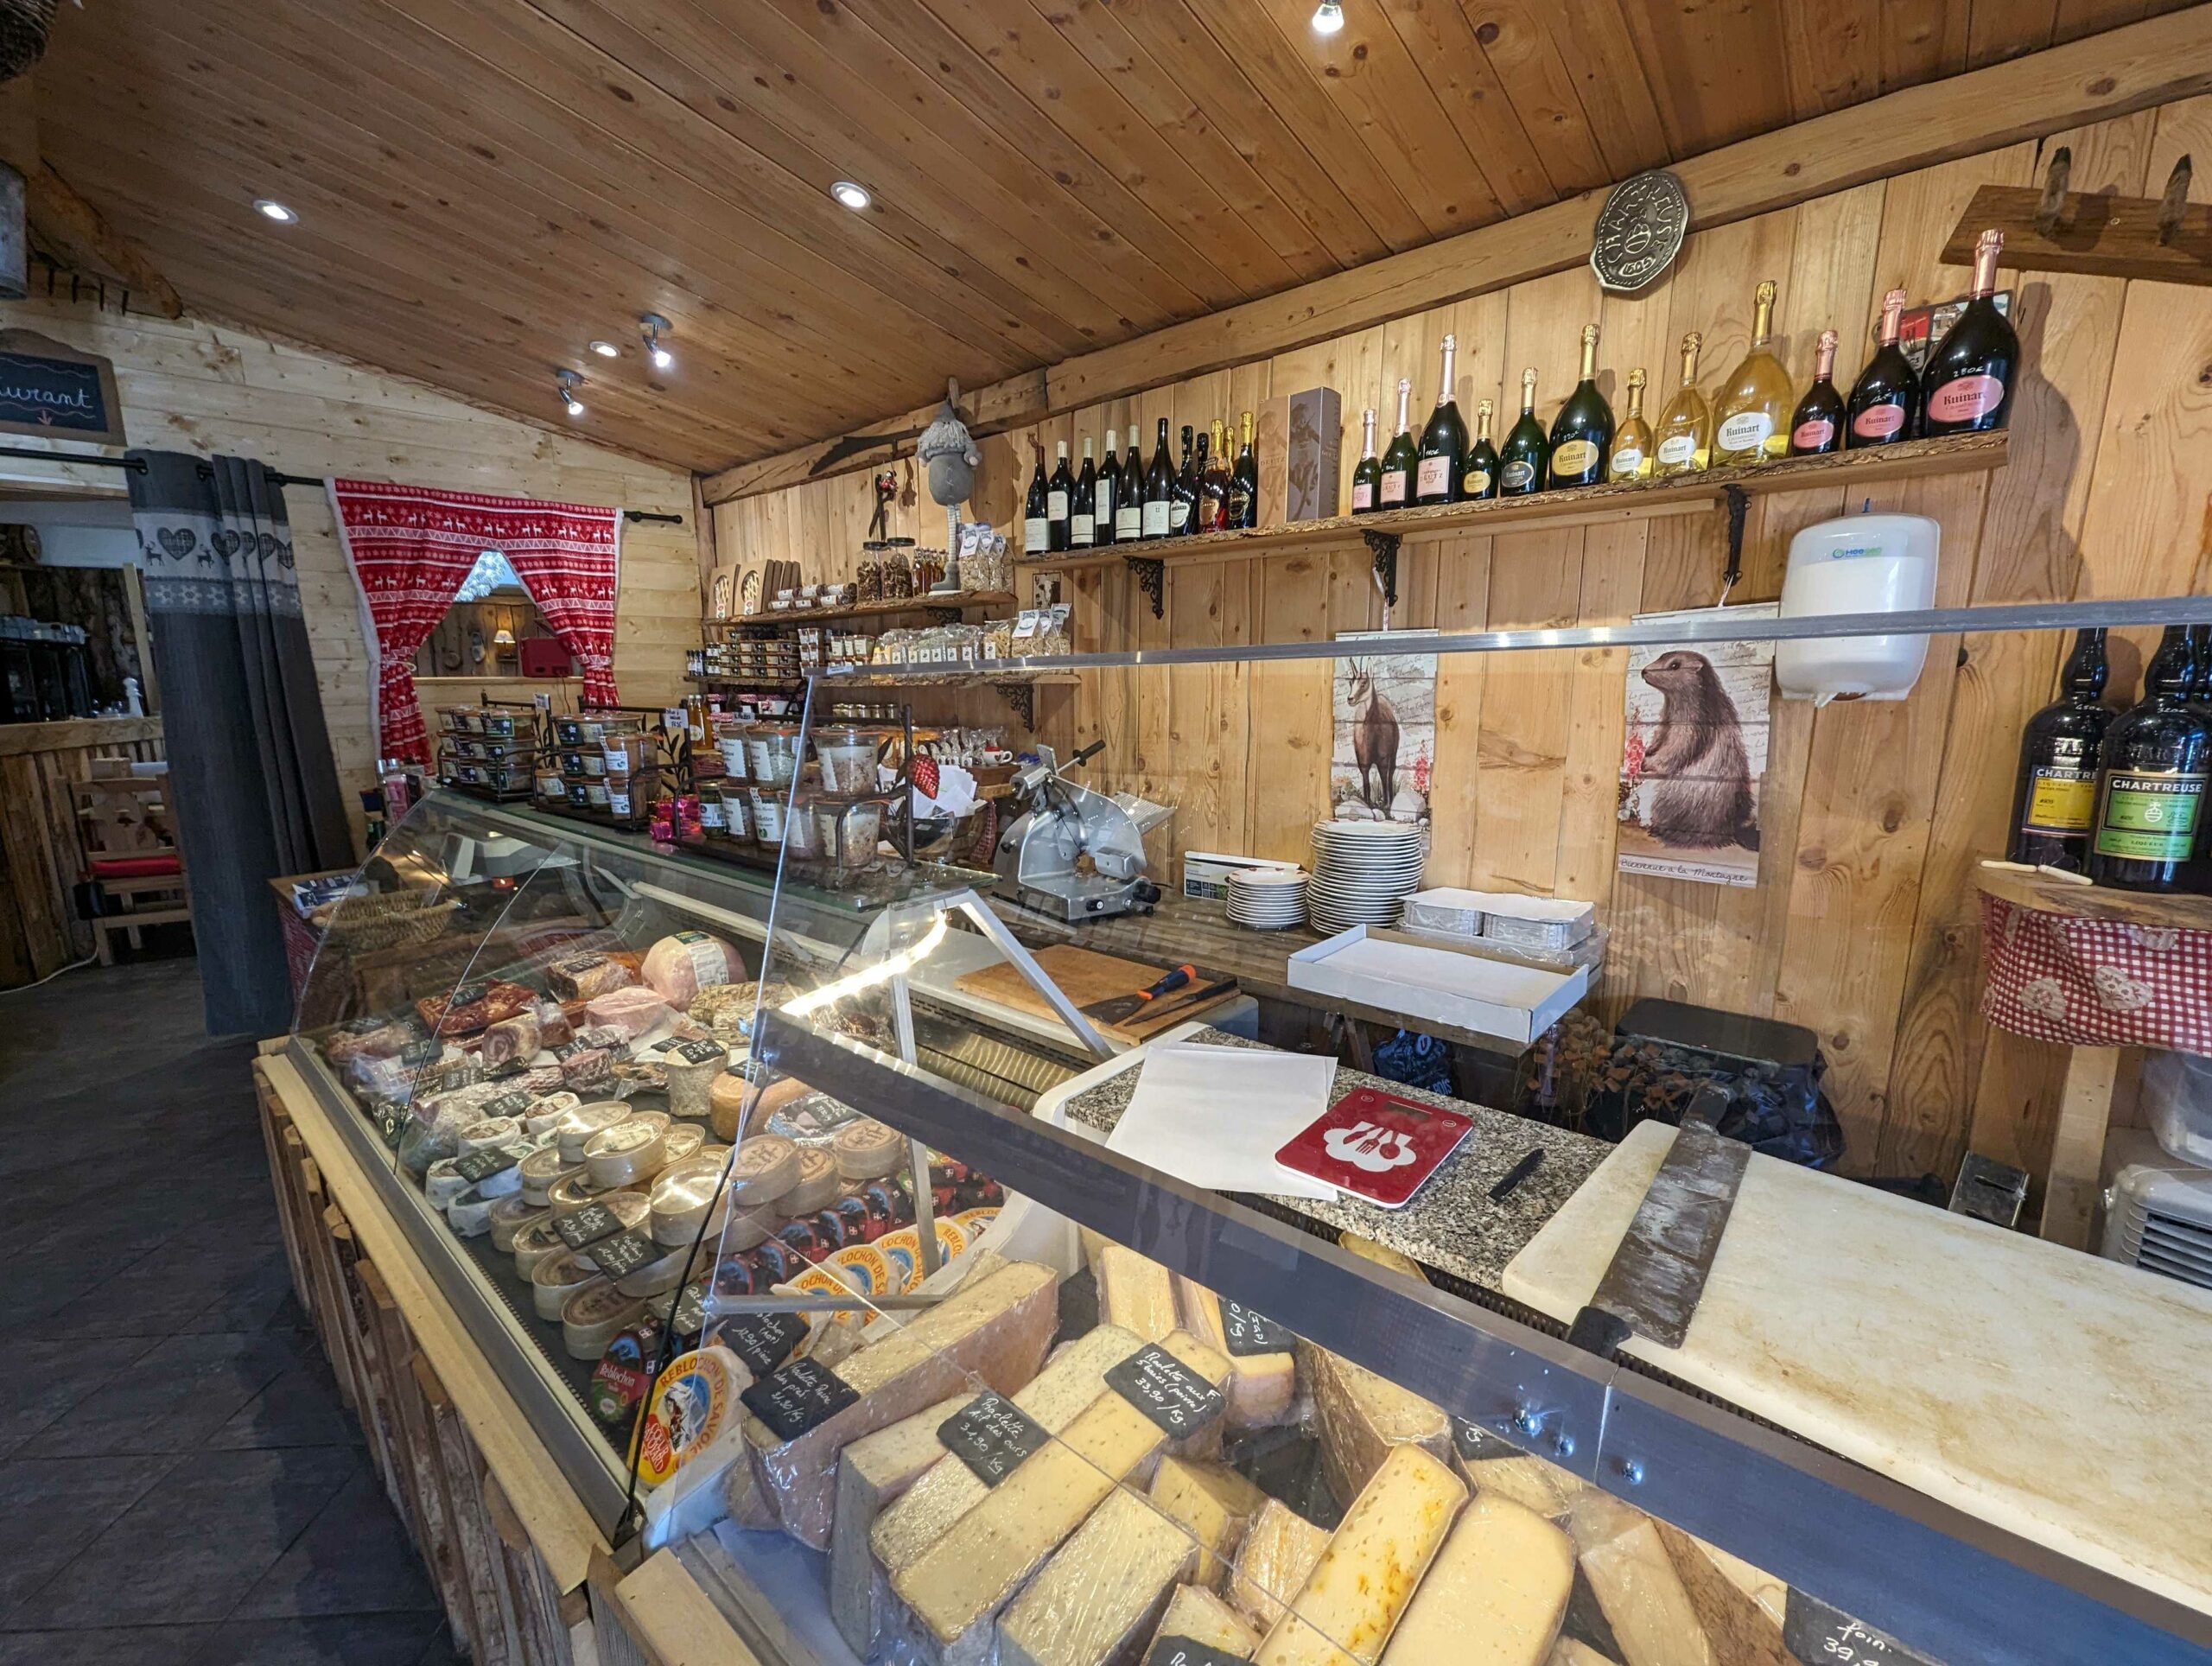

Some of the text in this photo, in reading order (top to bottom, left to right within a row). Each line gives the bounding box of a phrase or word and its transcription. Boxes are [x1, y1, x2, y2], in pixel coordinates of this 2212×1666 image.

[1726, 424, 1759, 436] Ruinart
[1559, 452, 1586, 463] Ruinart
[2037, 768, 2097, 779] CHARTR
[2113, 779, 2202, 793] CHARTREUSE
[1619, 857, 1666, 872] Bienvenue
[1677, 866, 1688, 874] la
[1693, 868, 1748, 885] Montagne
[882, 1236, 917, 1248] LOCHON
[838, 1250, 885, 1281] LOCHON DE
[756, 1313, 785, 1338] lochon
[600, 1364, 635, 1387] Reblochon
[659, 1356, 721, 1389] REBLOCHON
[715, 1381, 725, 1401] DE
[982, 1397, 1024, 1439] Raclette
[969, 1410, 1027, 1458] Ail des ours
